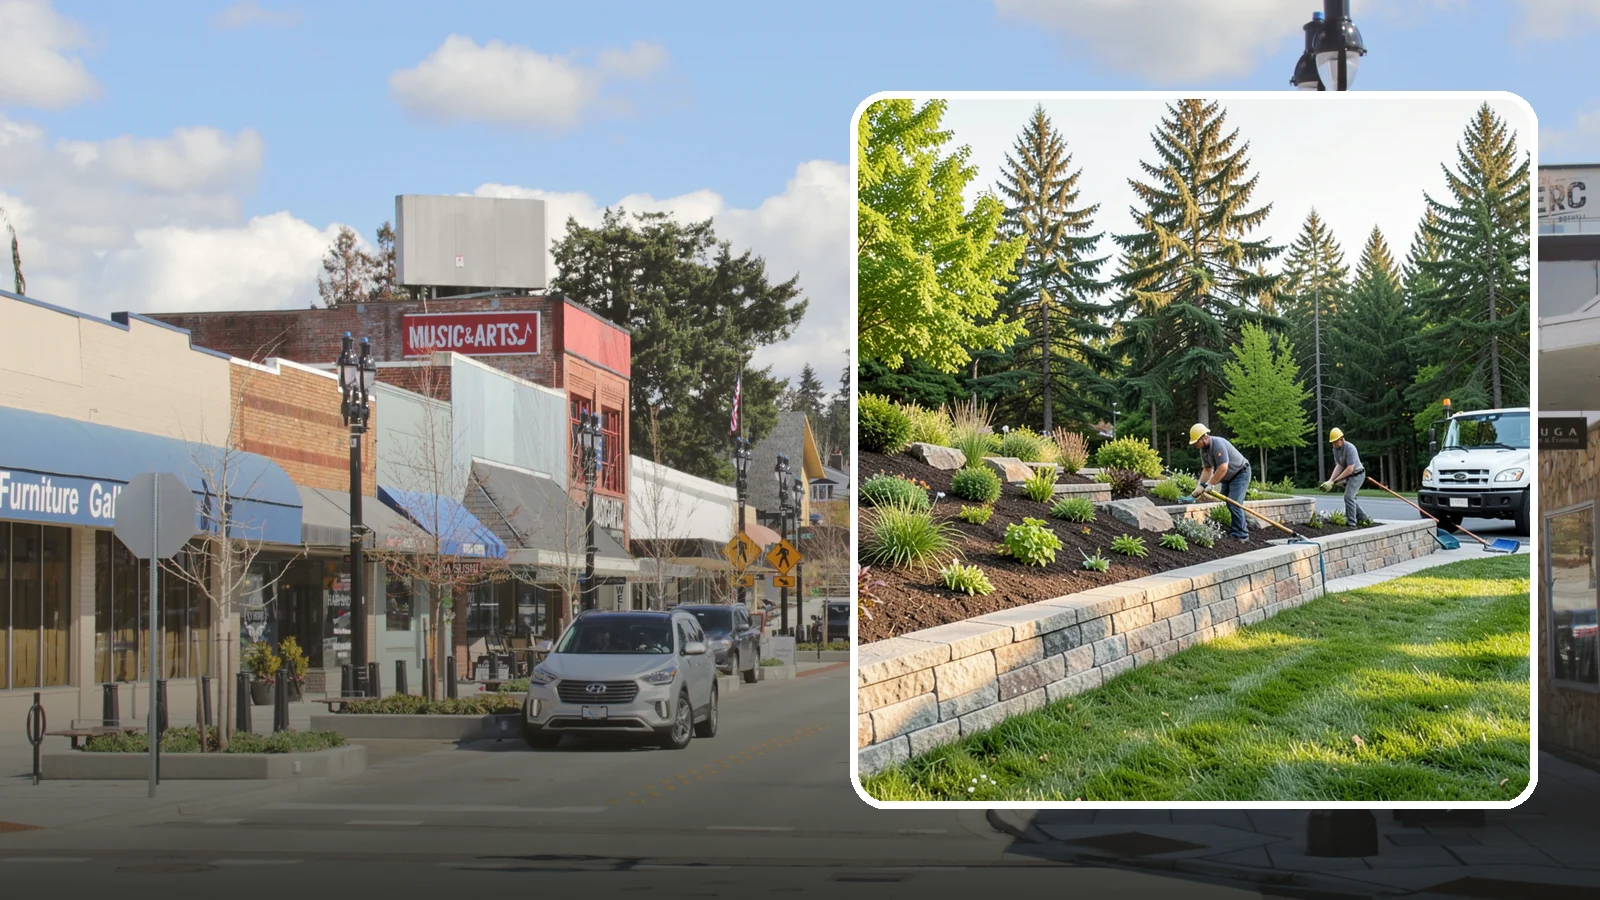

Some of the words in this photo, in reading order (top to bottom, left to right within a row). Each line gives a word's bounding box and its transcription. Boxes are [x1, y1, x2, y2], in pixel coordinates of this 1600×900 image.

[1540, 427, 1577, 436] UGA
[0, 472, 79, 515] Furniture
[453, 563, 479, 574] SUSHI
